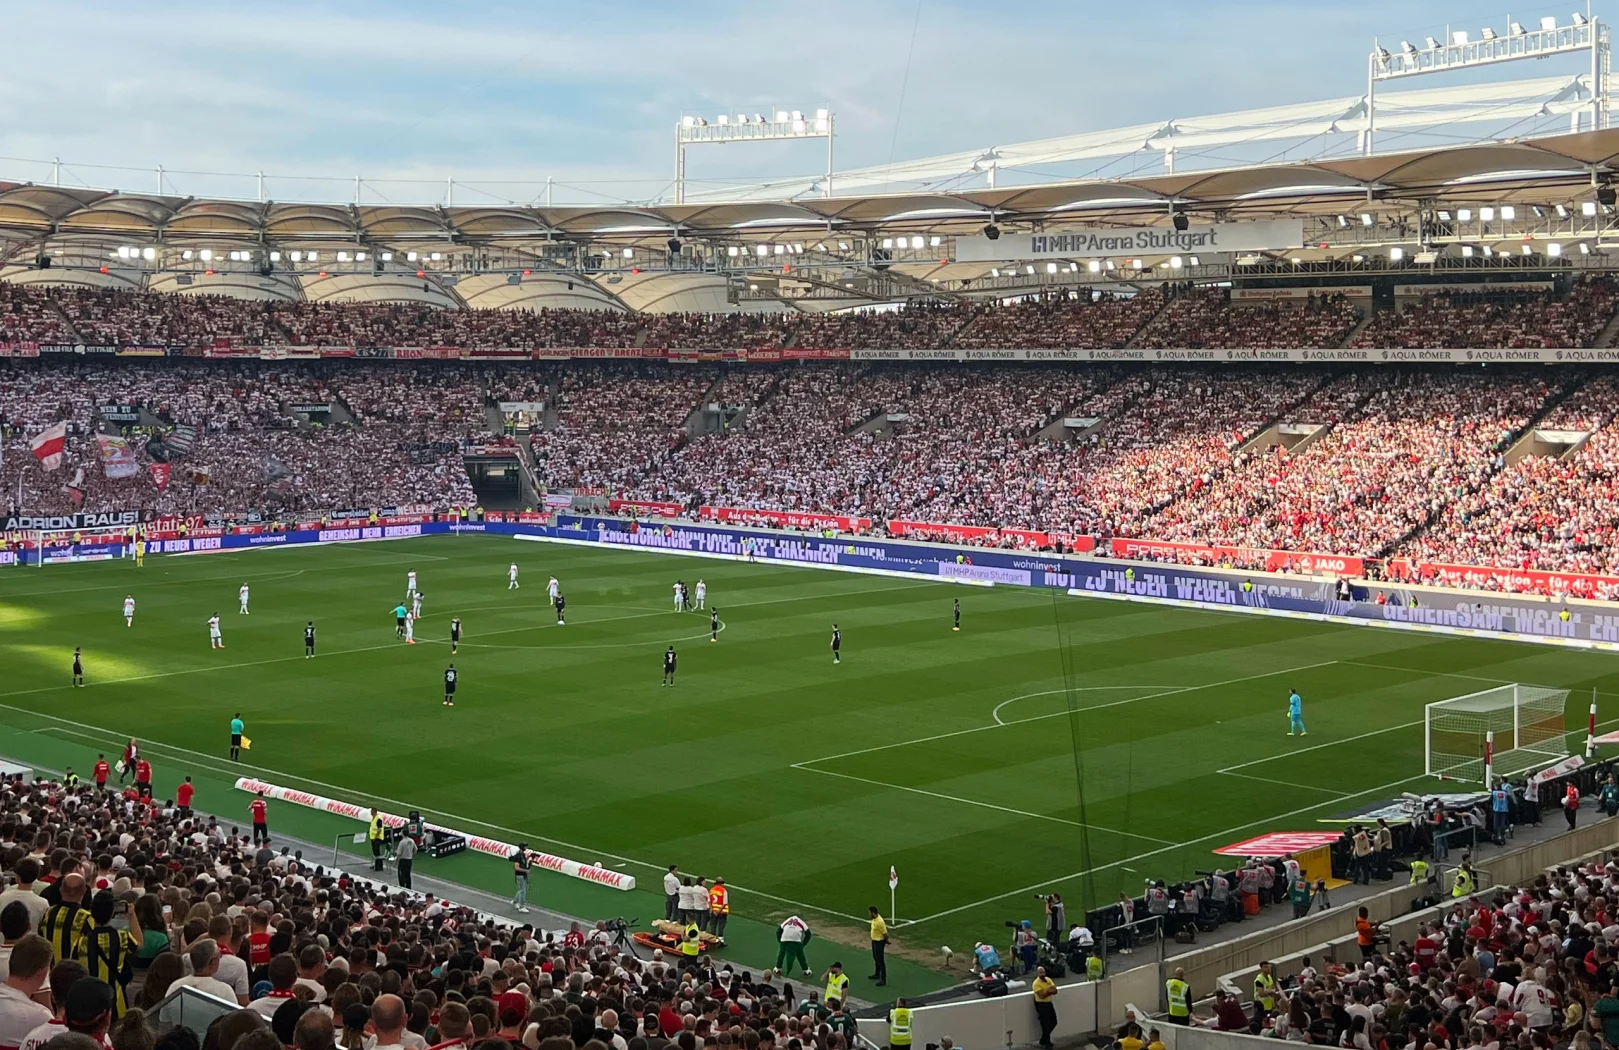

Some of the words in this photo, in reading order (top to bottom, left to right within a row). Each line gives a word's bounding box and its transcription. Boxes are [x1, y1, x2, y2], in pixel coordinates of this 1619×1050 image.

[1136, 228, 1217, 251] Stuttgart
[86, 345, 116, 353] STUTTGART
[570, 348, 605, 357] GIENGEN
[614, 348, 641, 357] BRENZ
[861, 351, 877, 359] AQUA
[879, 350, 899, 359] RÖMER
[915, 351, 932, 359] AQUA
[933, 350, 955, 359] RÖMER
[971, 351, 989, 359] AQUA
[991, 350, 1015, 359] RÖMER
[1162, 351, 1185, 360] AQUA
[1187, 350, 1214, 360] RÖMER
[1260, 350, 1289, 360] RÖMER
[1310, 351, 1335, 360] AQUA
[1337, 350, 1368, 360] RÖMER
[1390, 350, 1416, 360] AQUA
[1418, 349, 1451, 360] RÖMER
[1475, 350, 1503, 361] AQUA
[1505, 349, 1540, 361] RÖMER
[1032, 351, 1050, 360] AQUA
[1565, 350, 1595, 361] AQUA
[574, 487, 607, 497] URBACH
[5, 514, 77, 531] ADRION
[84, 510, 139, 527] RAUS!
[185, 515, 203, 529] 97
[728, 510, 742, 521] Aus
[788, 514, 800, 526] für
[319, 528, 360, 541] GEMEINSAM
[362, 527, 381, 538] MEHR
[384, 524, 422, 537] ERREICHEN
[449, 523, 486, 531] wohninvest
[150, 541, 161, 553] ZU
[164, 539, 190, 552] NEUEN
[193, 537, 221, 550] WEGEN
[250, 534, 287, 544] wohninvest
[1314, 557, 1346, 571] JAKO
[990, 569, 1024, 583] Stuttgart
[1549, 576, 1569, 590] für
[241, 779, 273, 796] WINAMAX
[283, 789, 319, 807] WINAMAX
[326, 800, 364, 818] WINAMAX
[468, 837, 511, 856] WINAMAX
[577, 865, 624, 887] WINAMAX
